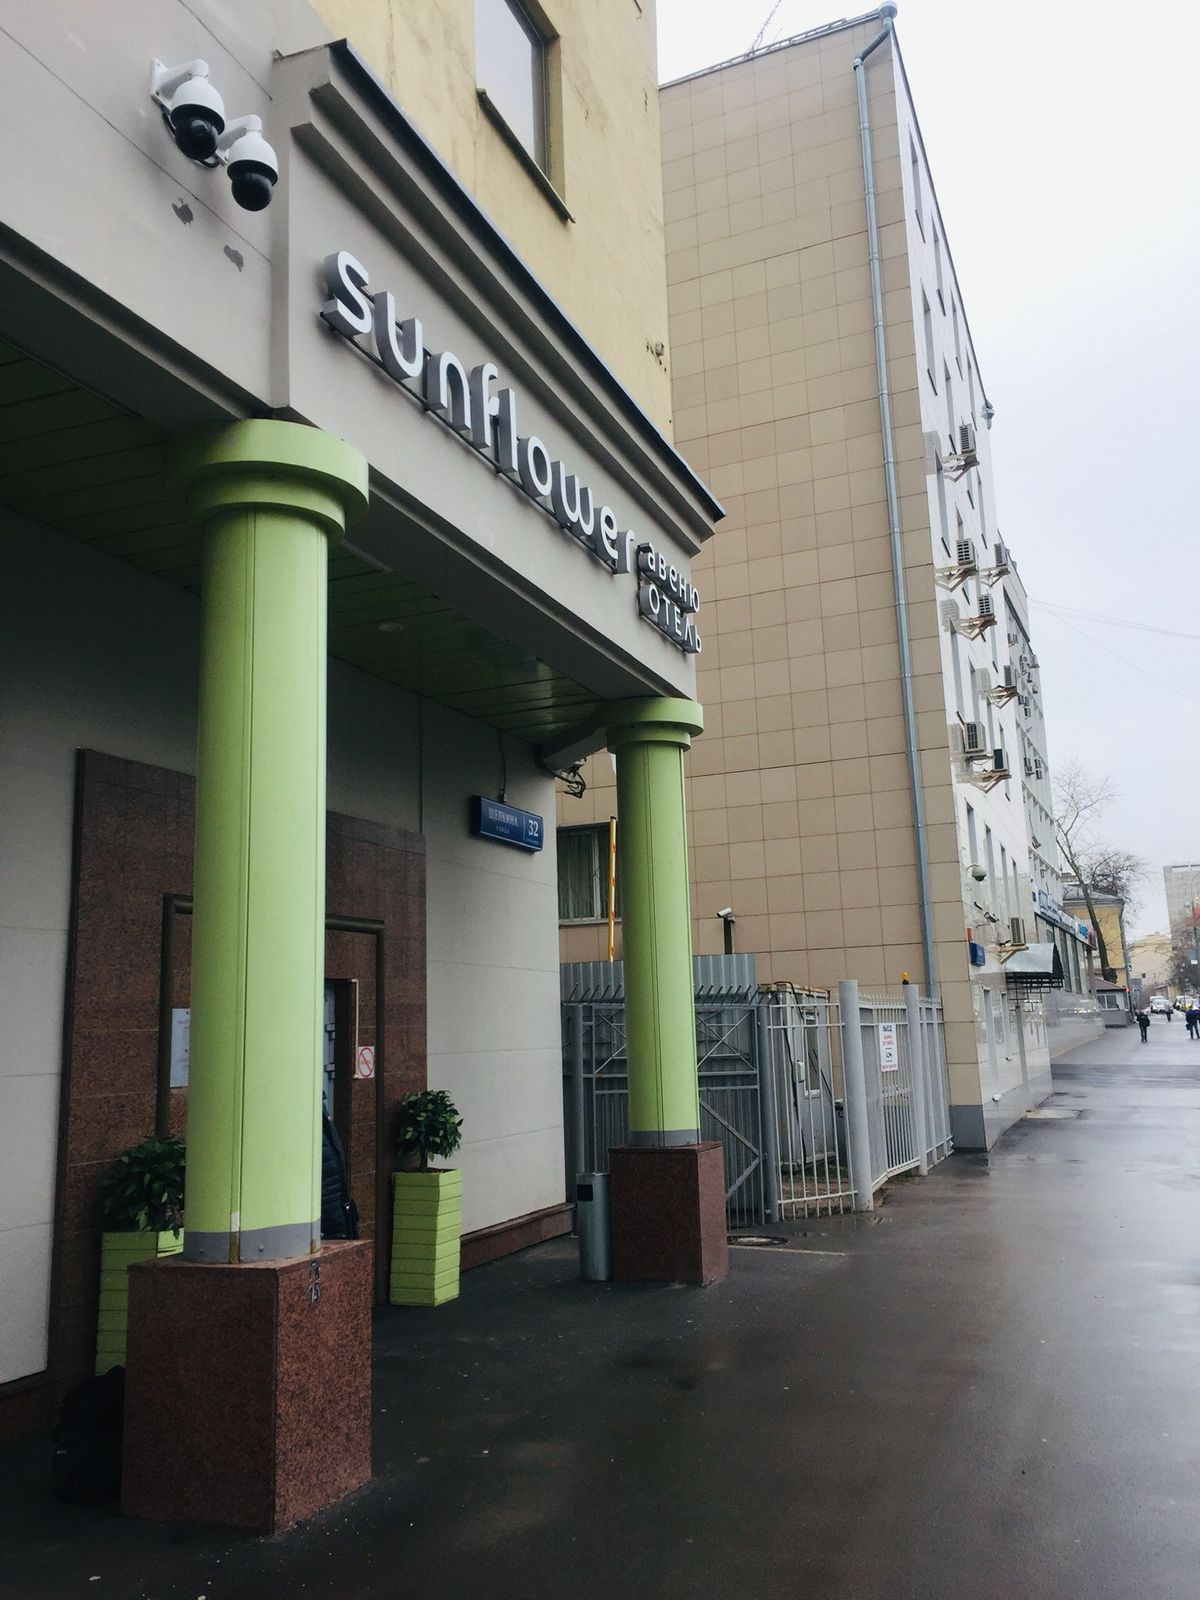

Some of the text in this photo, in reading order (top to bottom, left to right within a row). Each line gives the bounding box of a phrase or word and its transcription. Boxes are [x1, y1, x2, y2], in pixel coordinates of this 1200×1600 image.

[324, 250, 635, 575] sunflower
[640, 543, 700, 613] авеню
[640, 584, 702, 653] ОТЕЛЬ
[528, 819, 539, 837] 32
